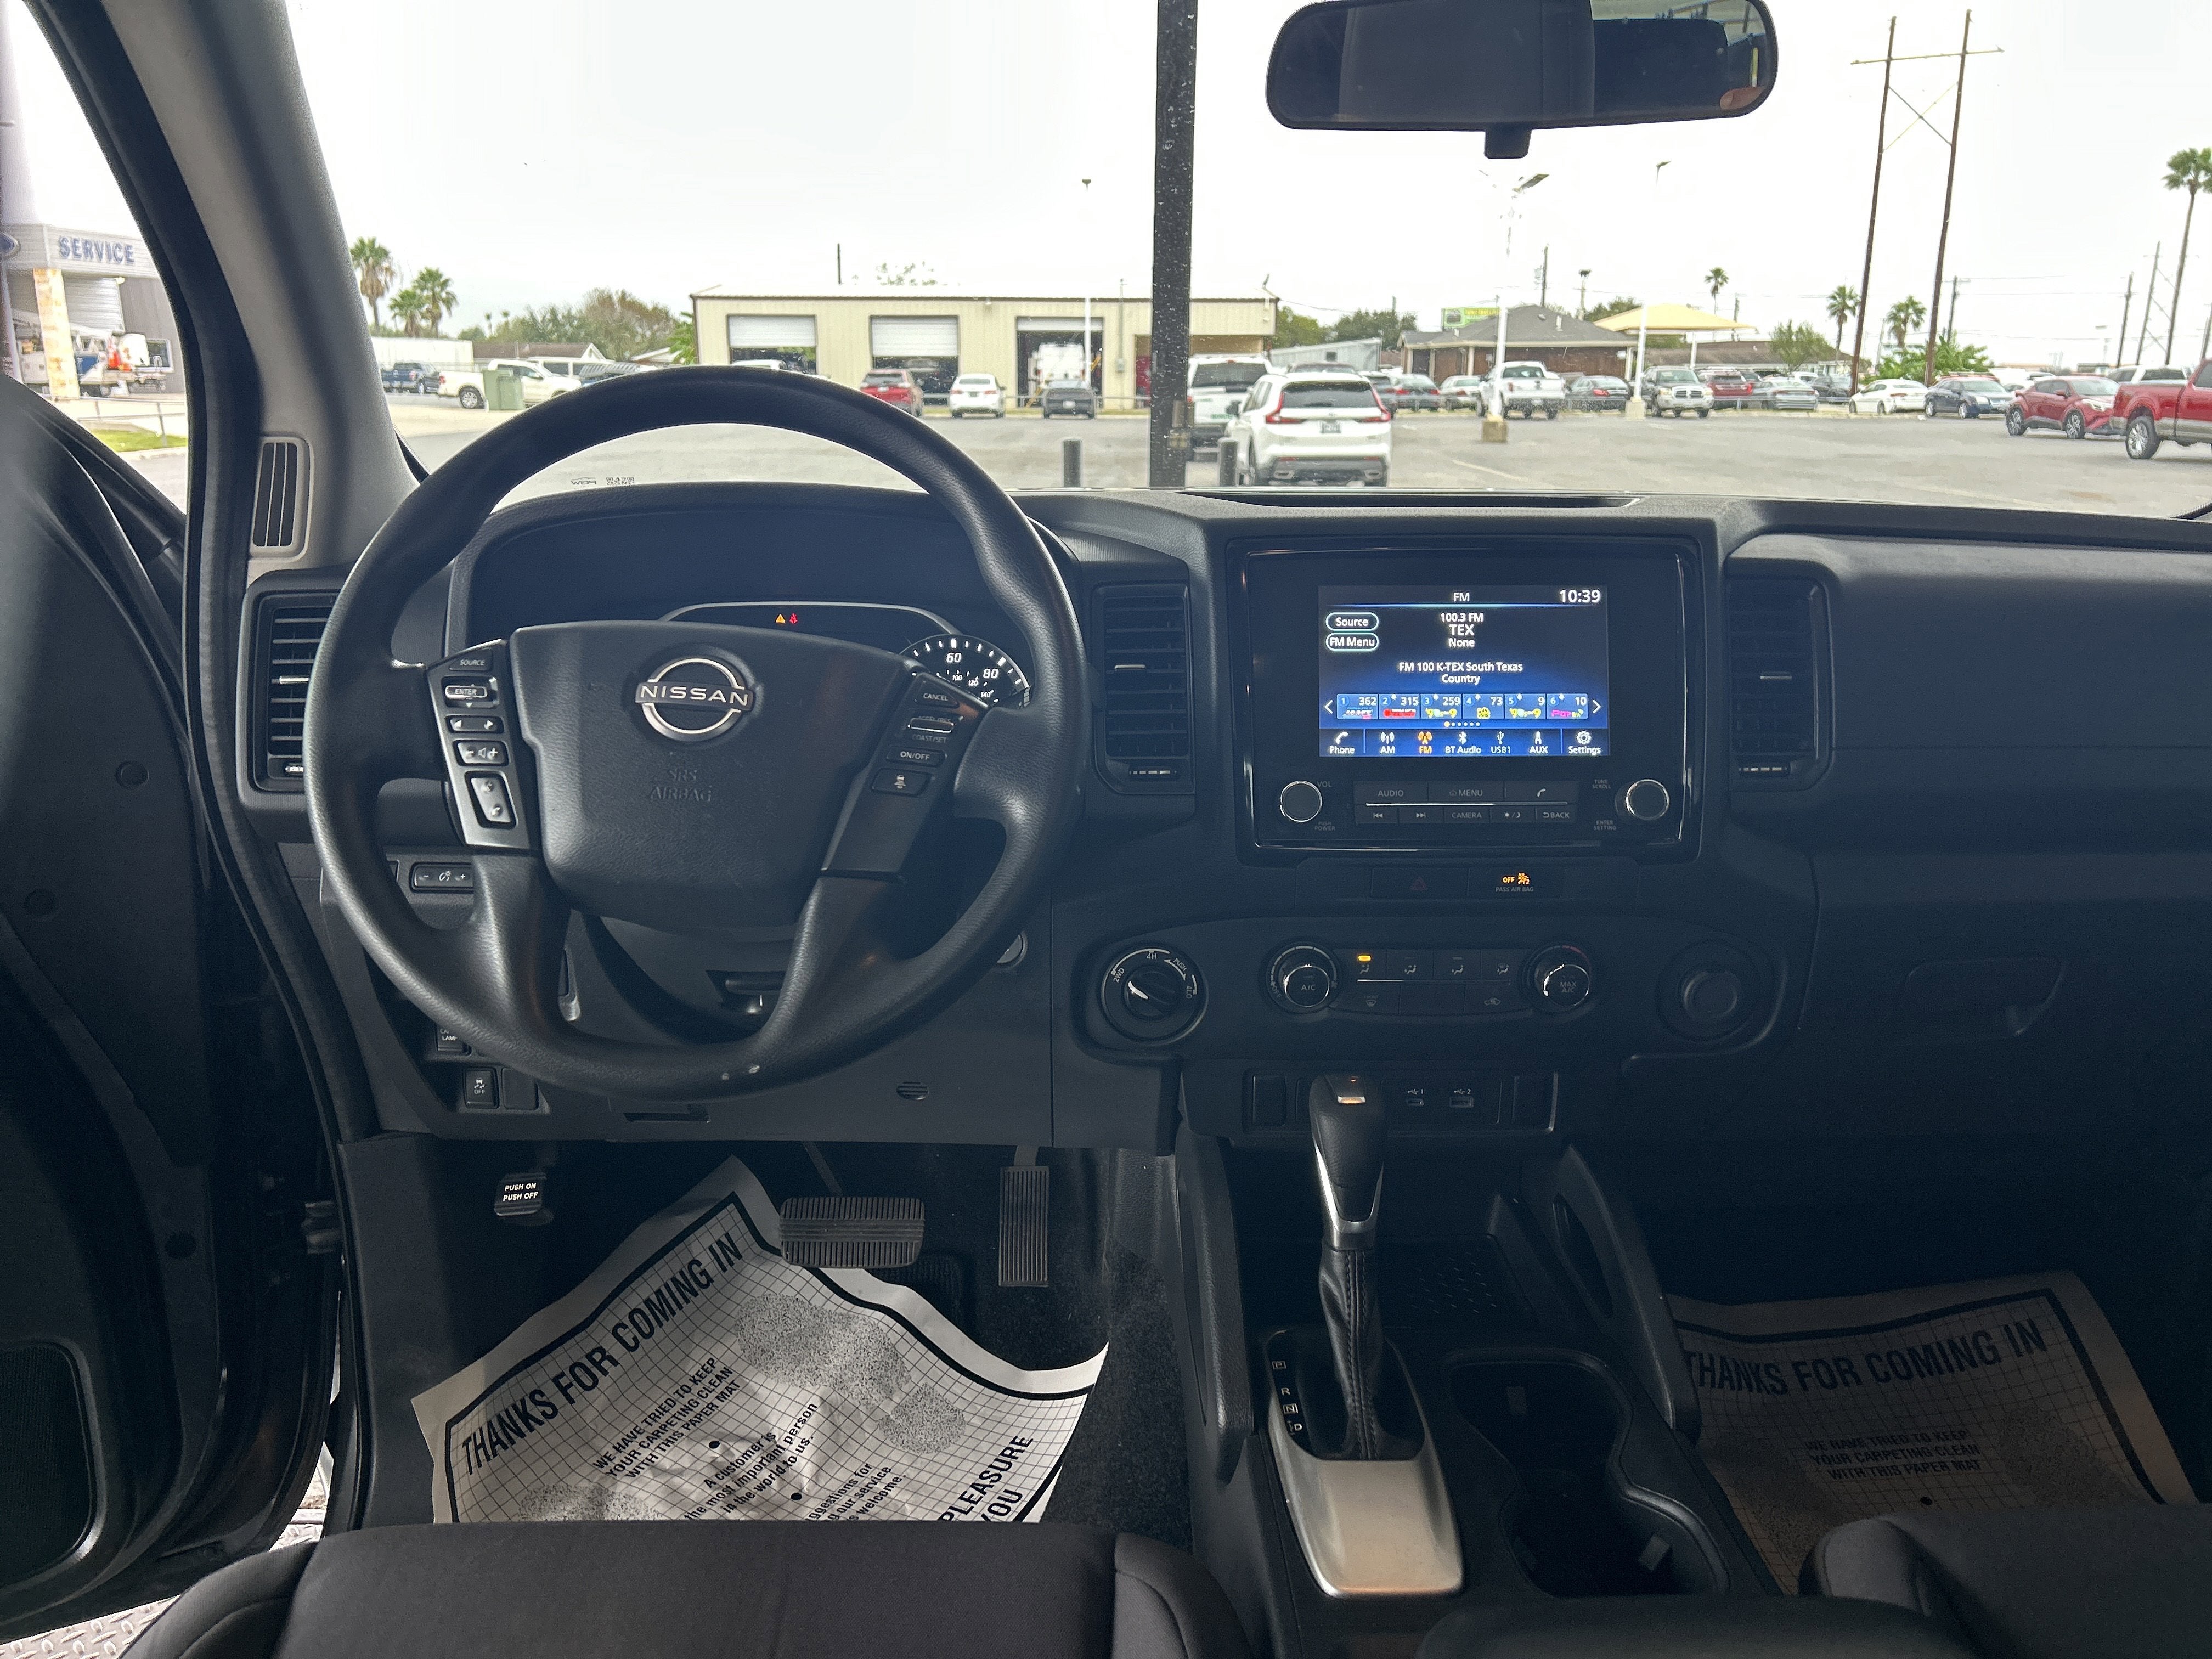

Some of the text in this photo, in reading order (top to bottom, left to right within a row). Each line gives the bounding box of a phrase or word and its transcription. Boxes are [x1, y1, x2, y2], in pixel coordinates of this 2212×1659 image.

[59, 235, 135, 264] SERVICE
[1453, 593, 1470, 602] FM
[1559, 589, 1601, 603] 10:39
[1336, 617, 1368, 627] Source
[1440, 613, 1483, 622] 100.3 FM
[1449, 625, 1474, 636] TEX
[1330, 637, 1375, 646] FM Menu
[1449, 639, 1475, 647] None
[946, 652, 962, 663] 60
[1399, 662, 1523, 671] FM 100 K-TEX South Texas
[983, 668, 999, 679] 80
[1442, 674, 1480, 685] Country
[640, 685, 749, 706] NISSAN
[923, 693, 949, 702] CANCEL
[1359, 697, 1377, 706] 362
[1401, 697, 1419, 706] 315
[1443, 697, 1460, 706] 259
[1490, 697, 1503, 706] 73
[1538, 697, 1544, 706] 9
[1575, 697, 1587, 706] 10
[912, 733, 947, 743] COAST/SET
[1330, 746, 1355, 754] Phone
[1458, 746, 1481, 754] Audio
[1568, 745, 1601, 755] Settings
[900, 751, 930, 761] ON/OFF
[651, 786, 712, 802] AIRBAG
[1173, 958, 1188, 972] PUSH
[1113, 968, 1125, 983] 2WD
[462, 1232, 743, 1475] THANKS FOR COMING IN
[1792, 1356, 1863, 1391] FOR
[1865, 1330, 2001, 1383] COMING
[2003, 1319, 2048, 1357] IN
[592, 1357, 716, 1469] WE HAVE TRIED TO KEEP
[606, 1367, 733, 1477] YOUR CARPETING CLEAN
[625, 1380, 740, 1478] WITH THIS PAPER MAT
[1804, 1430, 1968, 1451] WE HAVE TRIED TO KEEP
[1811, 1443, 1980, 1465] YOUR CARPETING CLEAN
[685, 1403, 817, 1520] the most important person
[704, 1432, 776, 1488] A customer is
[720, 1436, 814, 1514] in the world to us.
[854, 1463, 872, 1478] for
[1827, 1459, 1981, 1480] WITH THIS PAPER MAT
[938, 1435, 1033, 1521] PLEASURE
[837, 1466, 891, 1513] our service
[856, 1475, 906, 1514] welcome.
